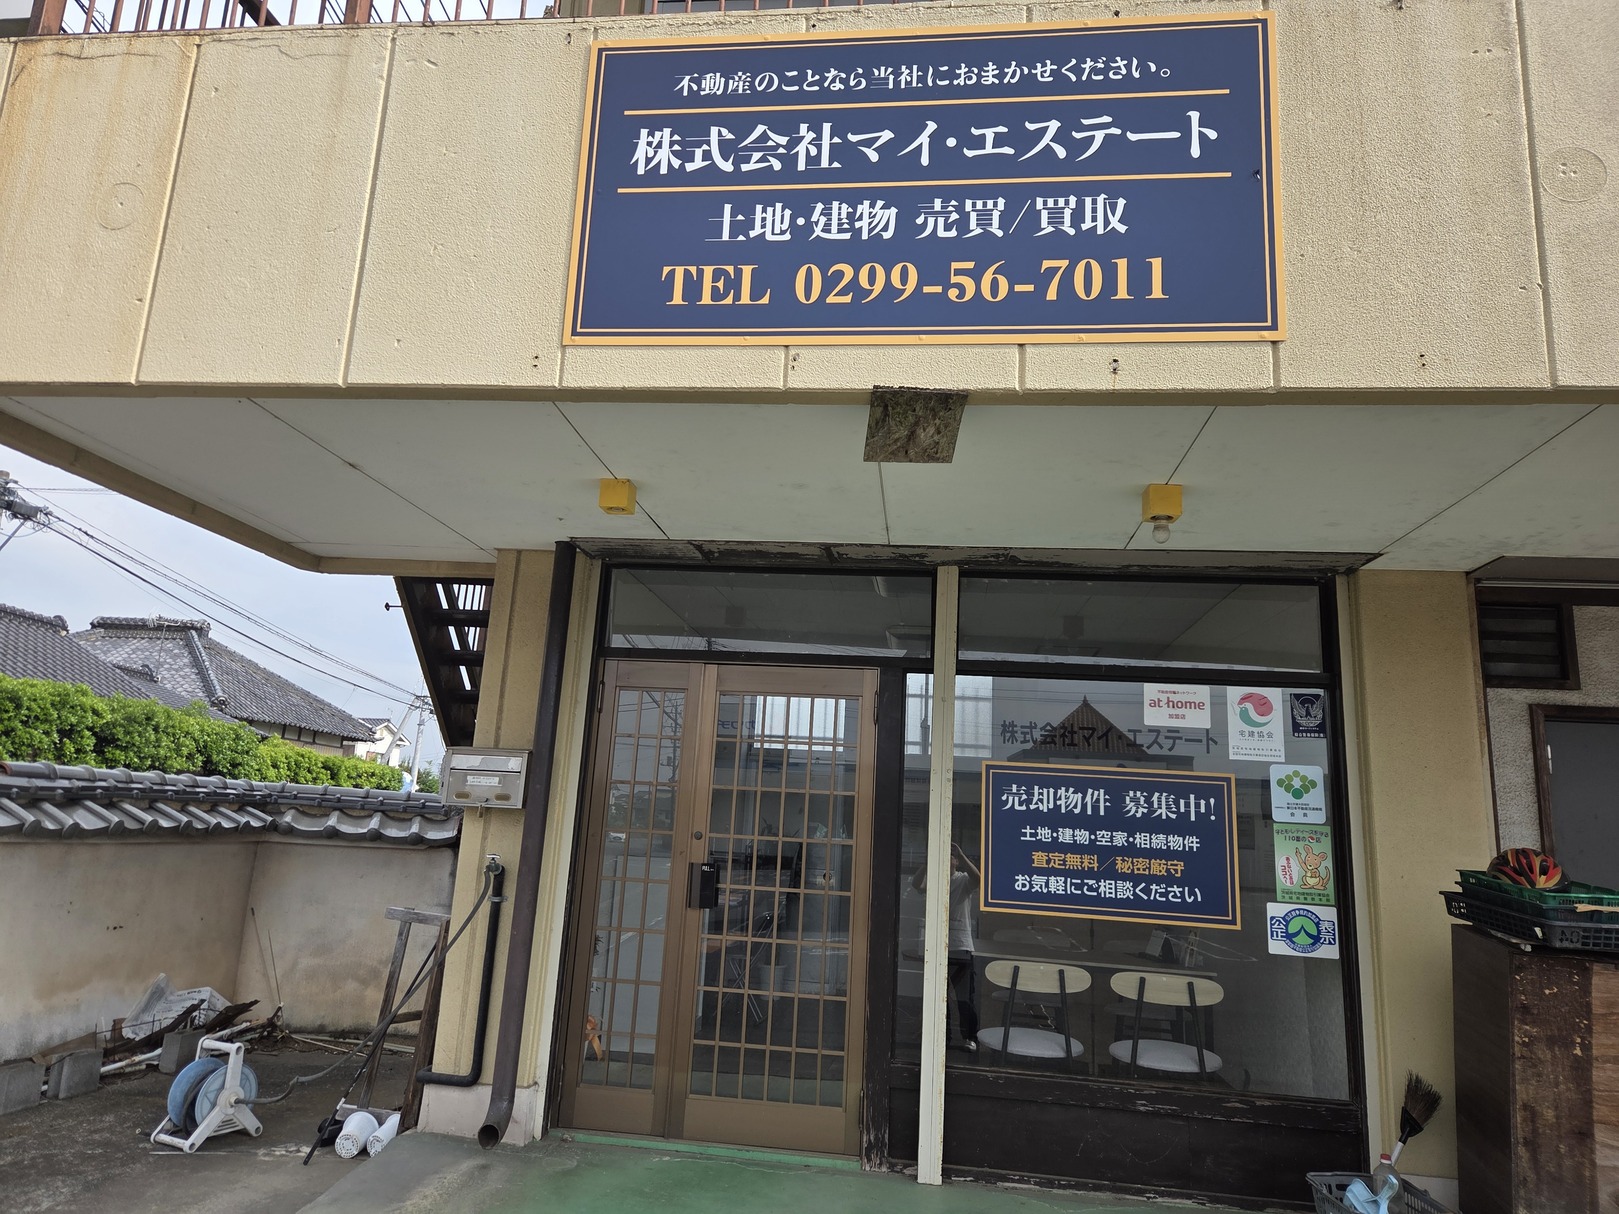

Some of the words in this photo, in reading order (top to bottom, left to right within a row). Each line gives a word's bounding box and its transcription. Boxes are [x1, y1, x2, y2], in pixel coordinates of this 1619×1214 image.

[673, 57, 1172, 97] 不動産のことなら当社におまかせください。
[629, 110, 1219, 176] 株式会社マイ・エステート
[661, 264, 771, 306] TEL
[795, 256, 1170, 304] 0299-56-7011
[1149, 697, 1163, 708] at
[1164, 696, 1206, 711] home
[1238, 729, 1275, 740] 宅建協会
[1001, 783, 1112, 816] 売却物件
[1122, 790, 1217, 822] 募集中!
[1014, 874, 1203, 903] お気軽にご相談ください
[1271, 917, 1287, 941] 公正
[1319, 920, 1336, 945] 表示
